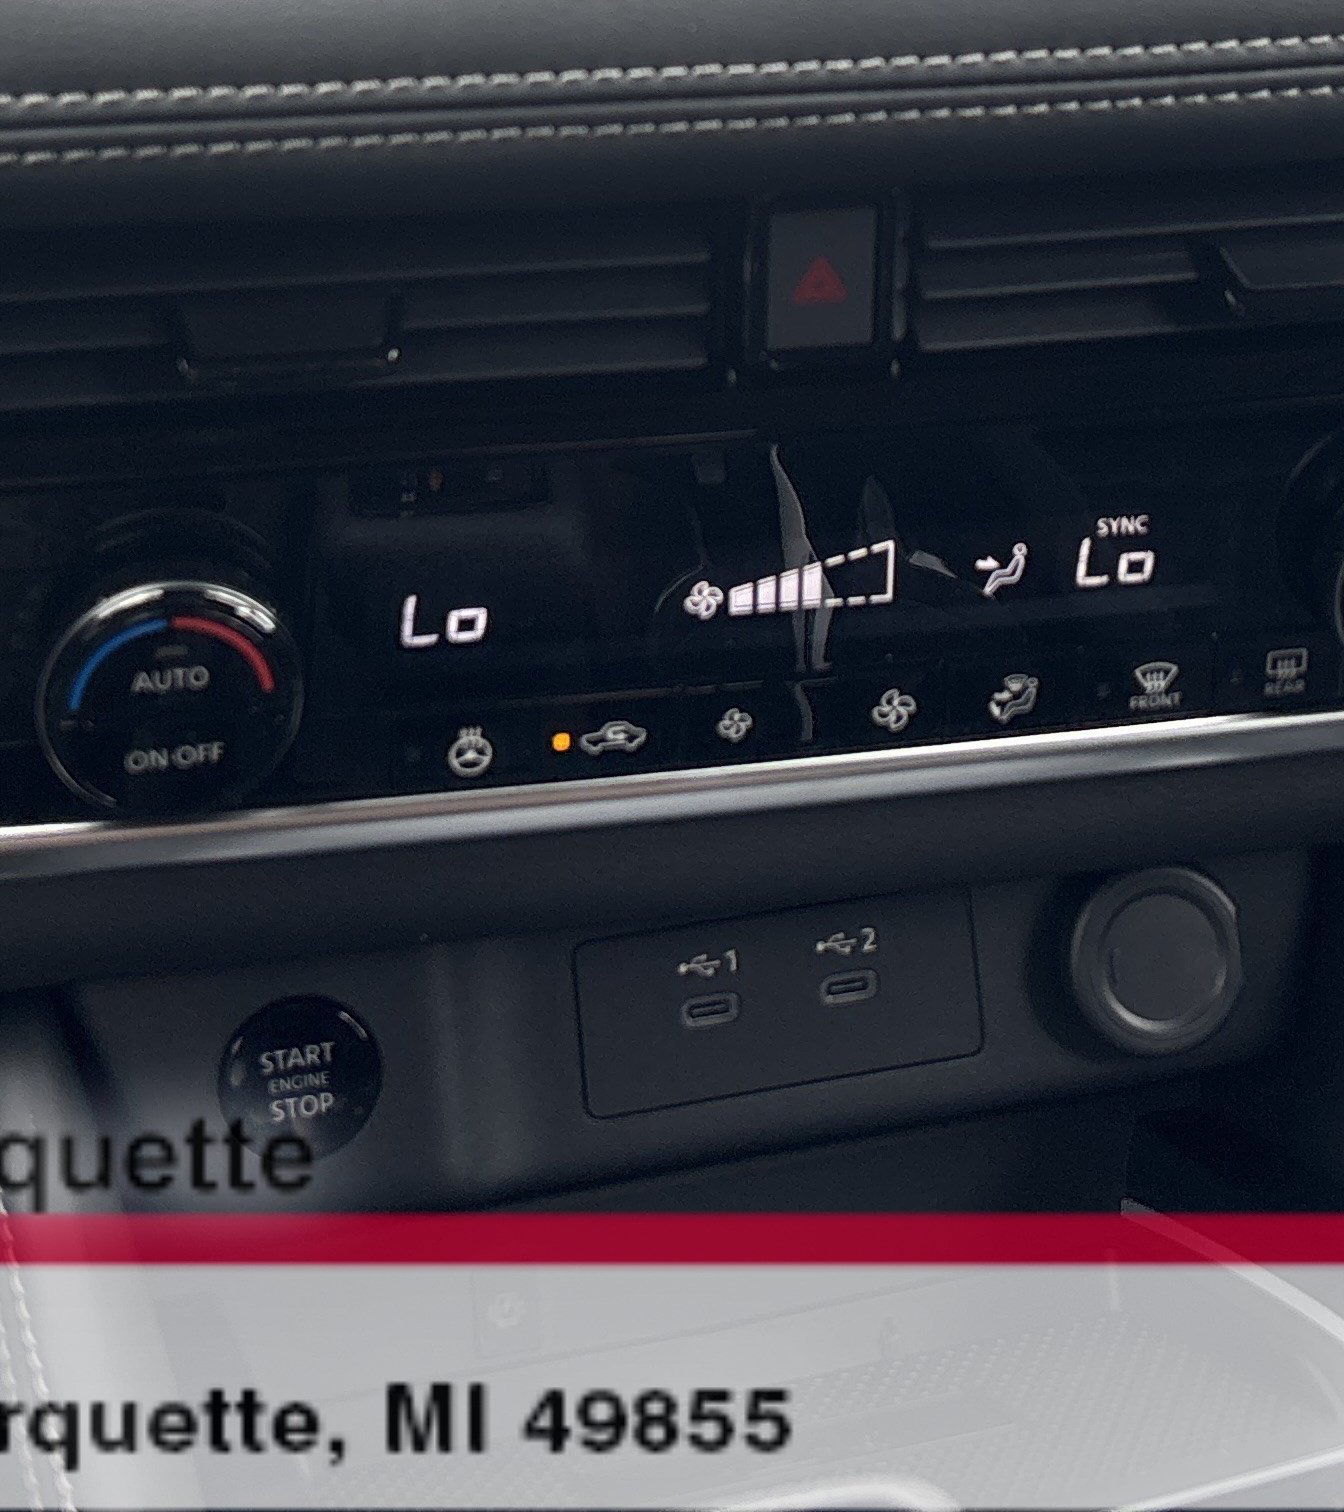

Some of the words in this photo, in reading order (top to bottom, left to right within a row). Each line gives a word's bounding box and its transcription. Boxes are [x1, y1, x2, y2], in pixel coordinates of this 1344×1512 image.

[1096, 514, 1149, 537] SYNC
[1076, 536, 1155, 588] Lo
[398, 594, 488, 650] Lo
[131, 665, 211, 695] AUTO
[1129, 691, 1183, 712] FRONT
[861, 926, 878, 953] 2
[723, 948, 738, 975] 1
[259, 1040, 336, 1076] START
[267, 1070, 331, 1095] ENGINE
[269, 1091, 336, 1123] STOP
